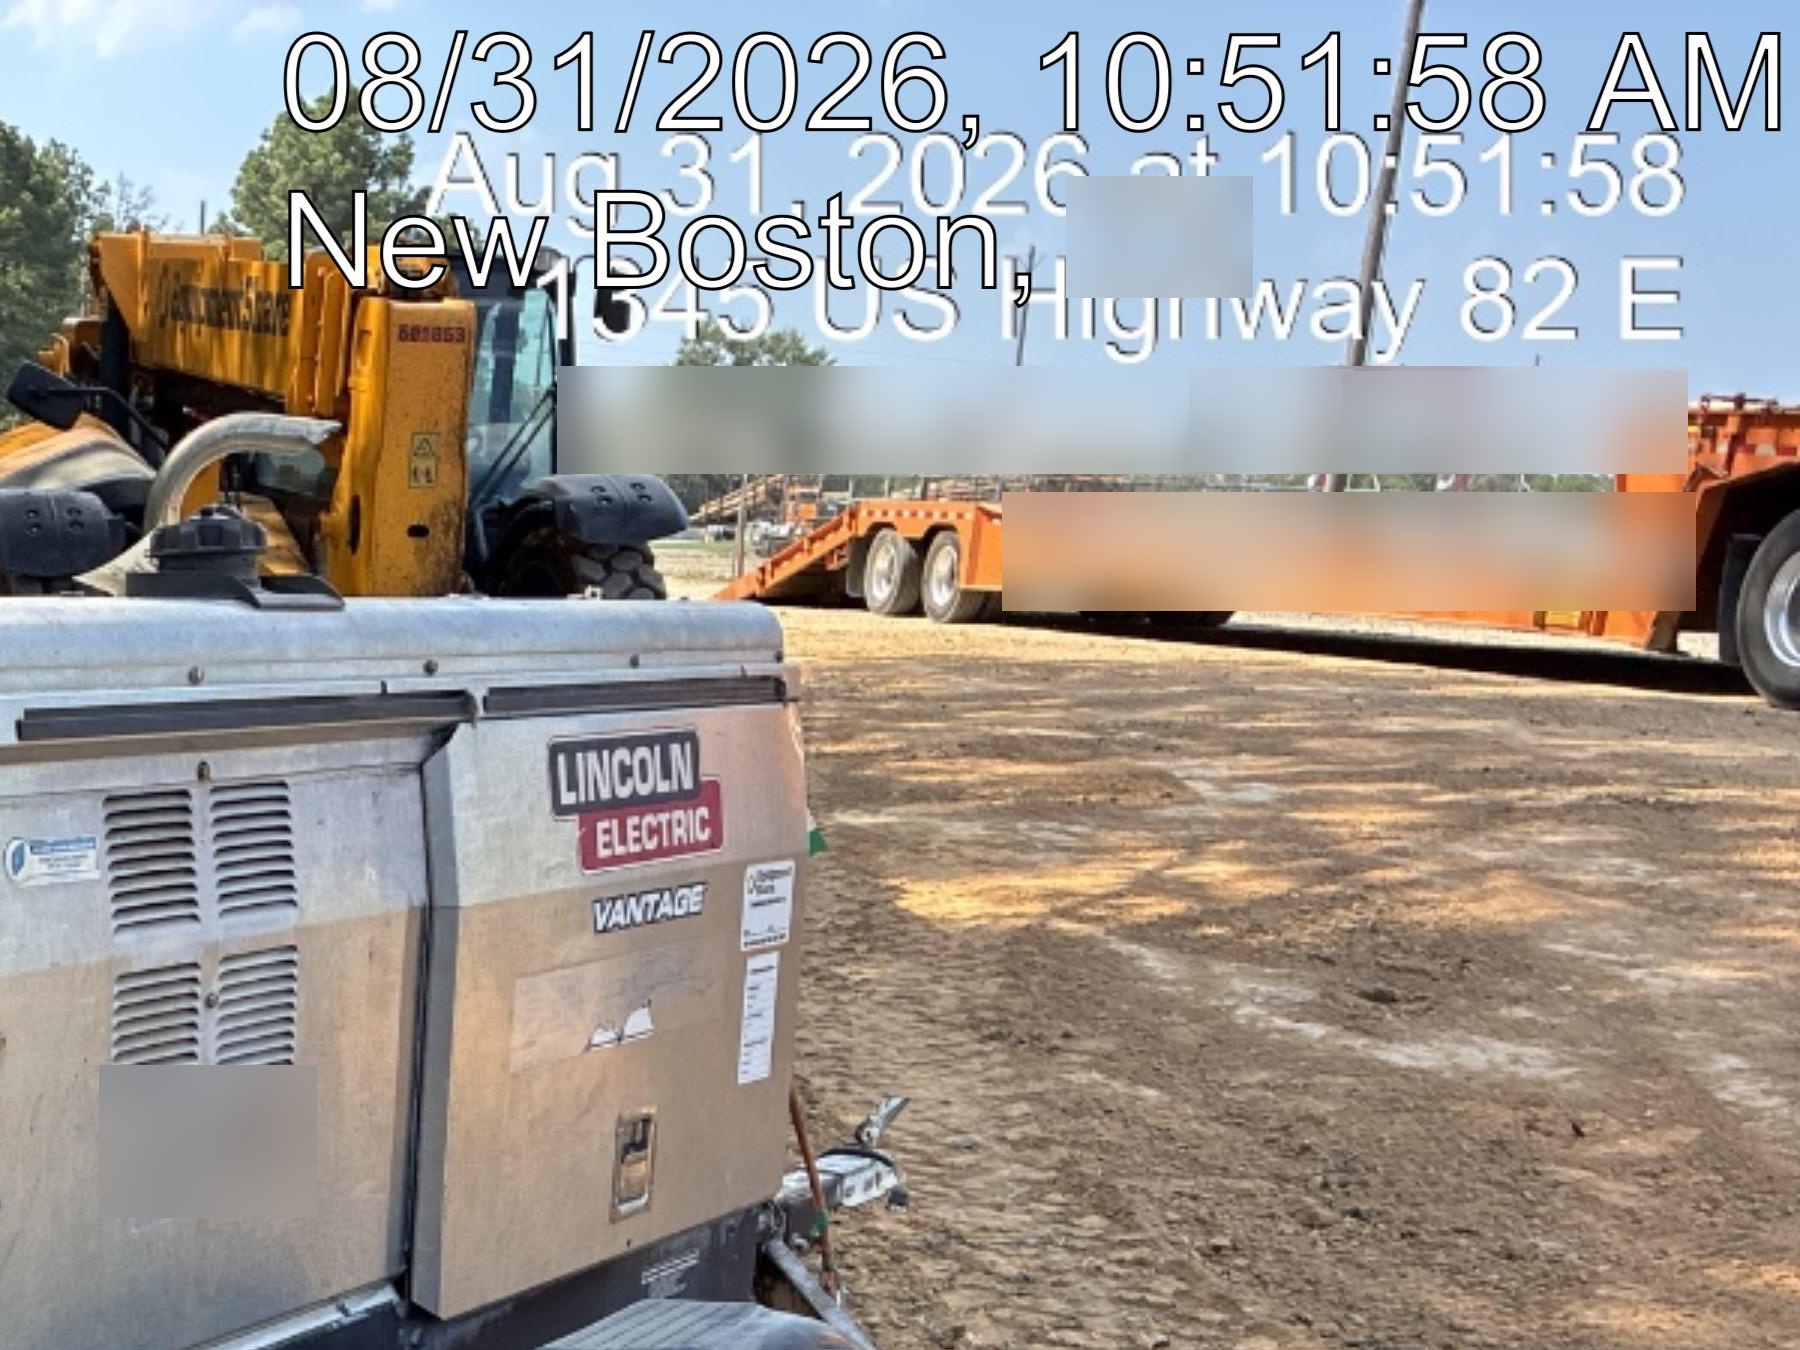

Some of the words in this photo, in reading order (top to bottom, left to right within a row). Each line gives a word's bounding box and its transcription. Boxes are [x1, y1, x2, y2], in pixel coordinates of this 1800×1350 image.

[556, 741, 694, 806] LINCOLN
[595, 806, 712, 859] ELECTRIC
[591, 882, 706, 934] VANTAGE
